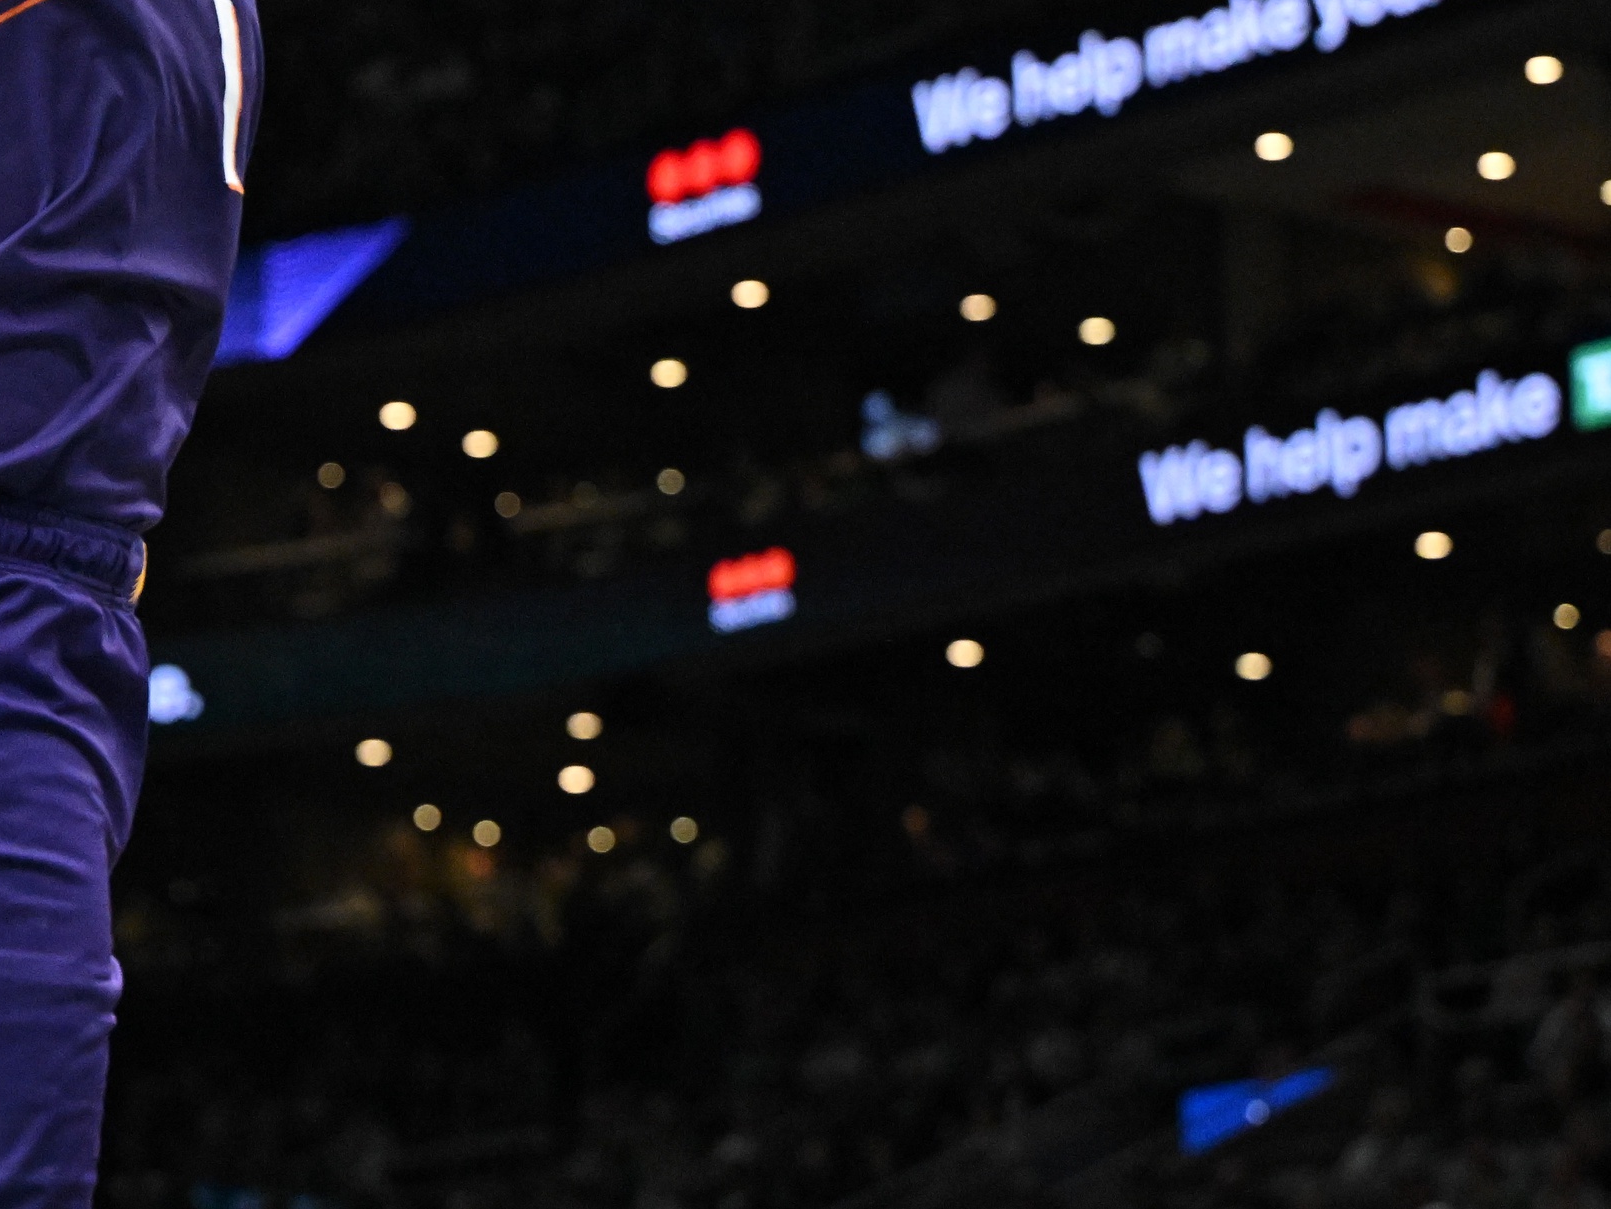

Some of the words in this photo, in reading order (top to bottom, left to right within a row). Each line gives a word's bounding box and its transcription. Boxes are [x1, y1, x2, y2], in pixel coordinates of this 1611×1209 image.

[912, 66, 1010, 155] We
[1010, 28, 1143, 128] help
[1139, 438, 1242, 526] We
[1242, 406, 1382, 504] help
[1384, 366, 1562, 471] make
